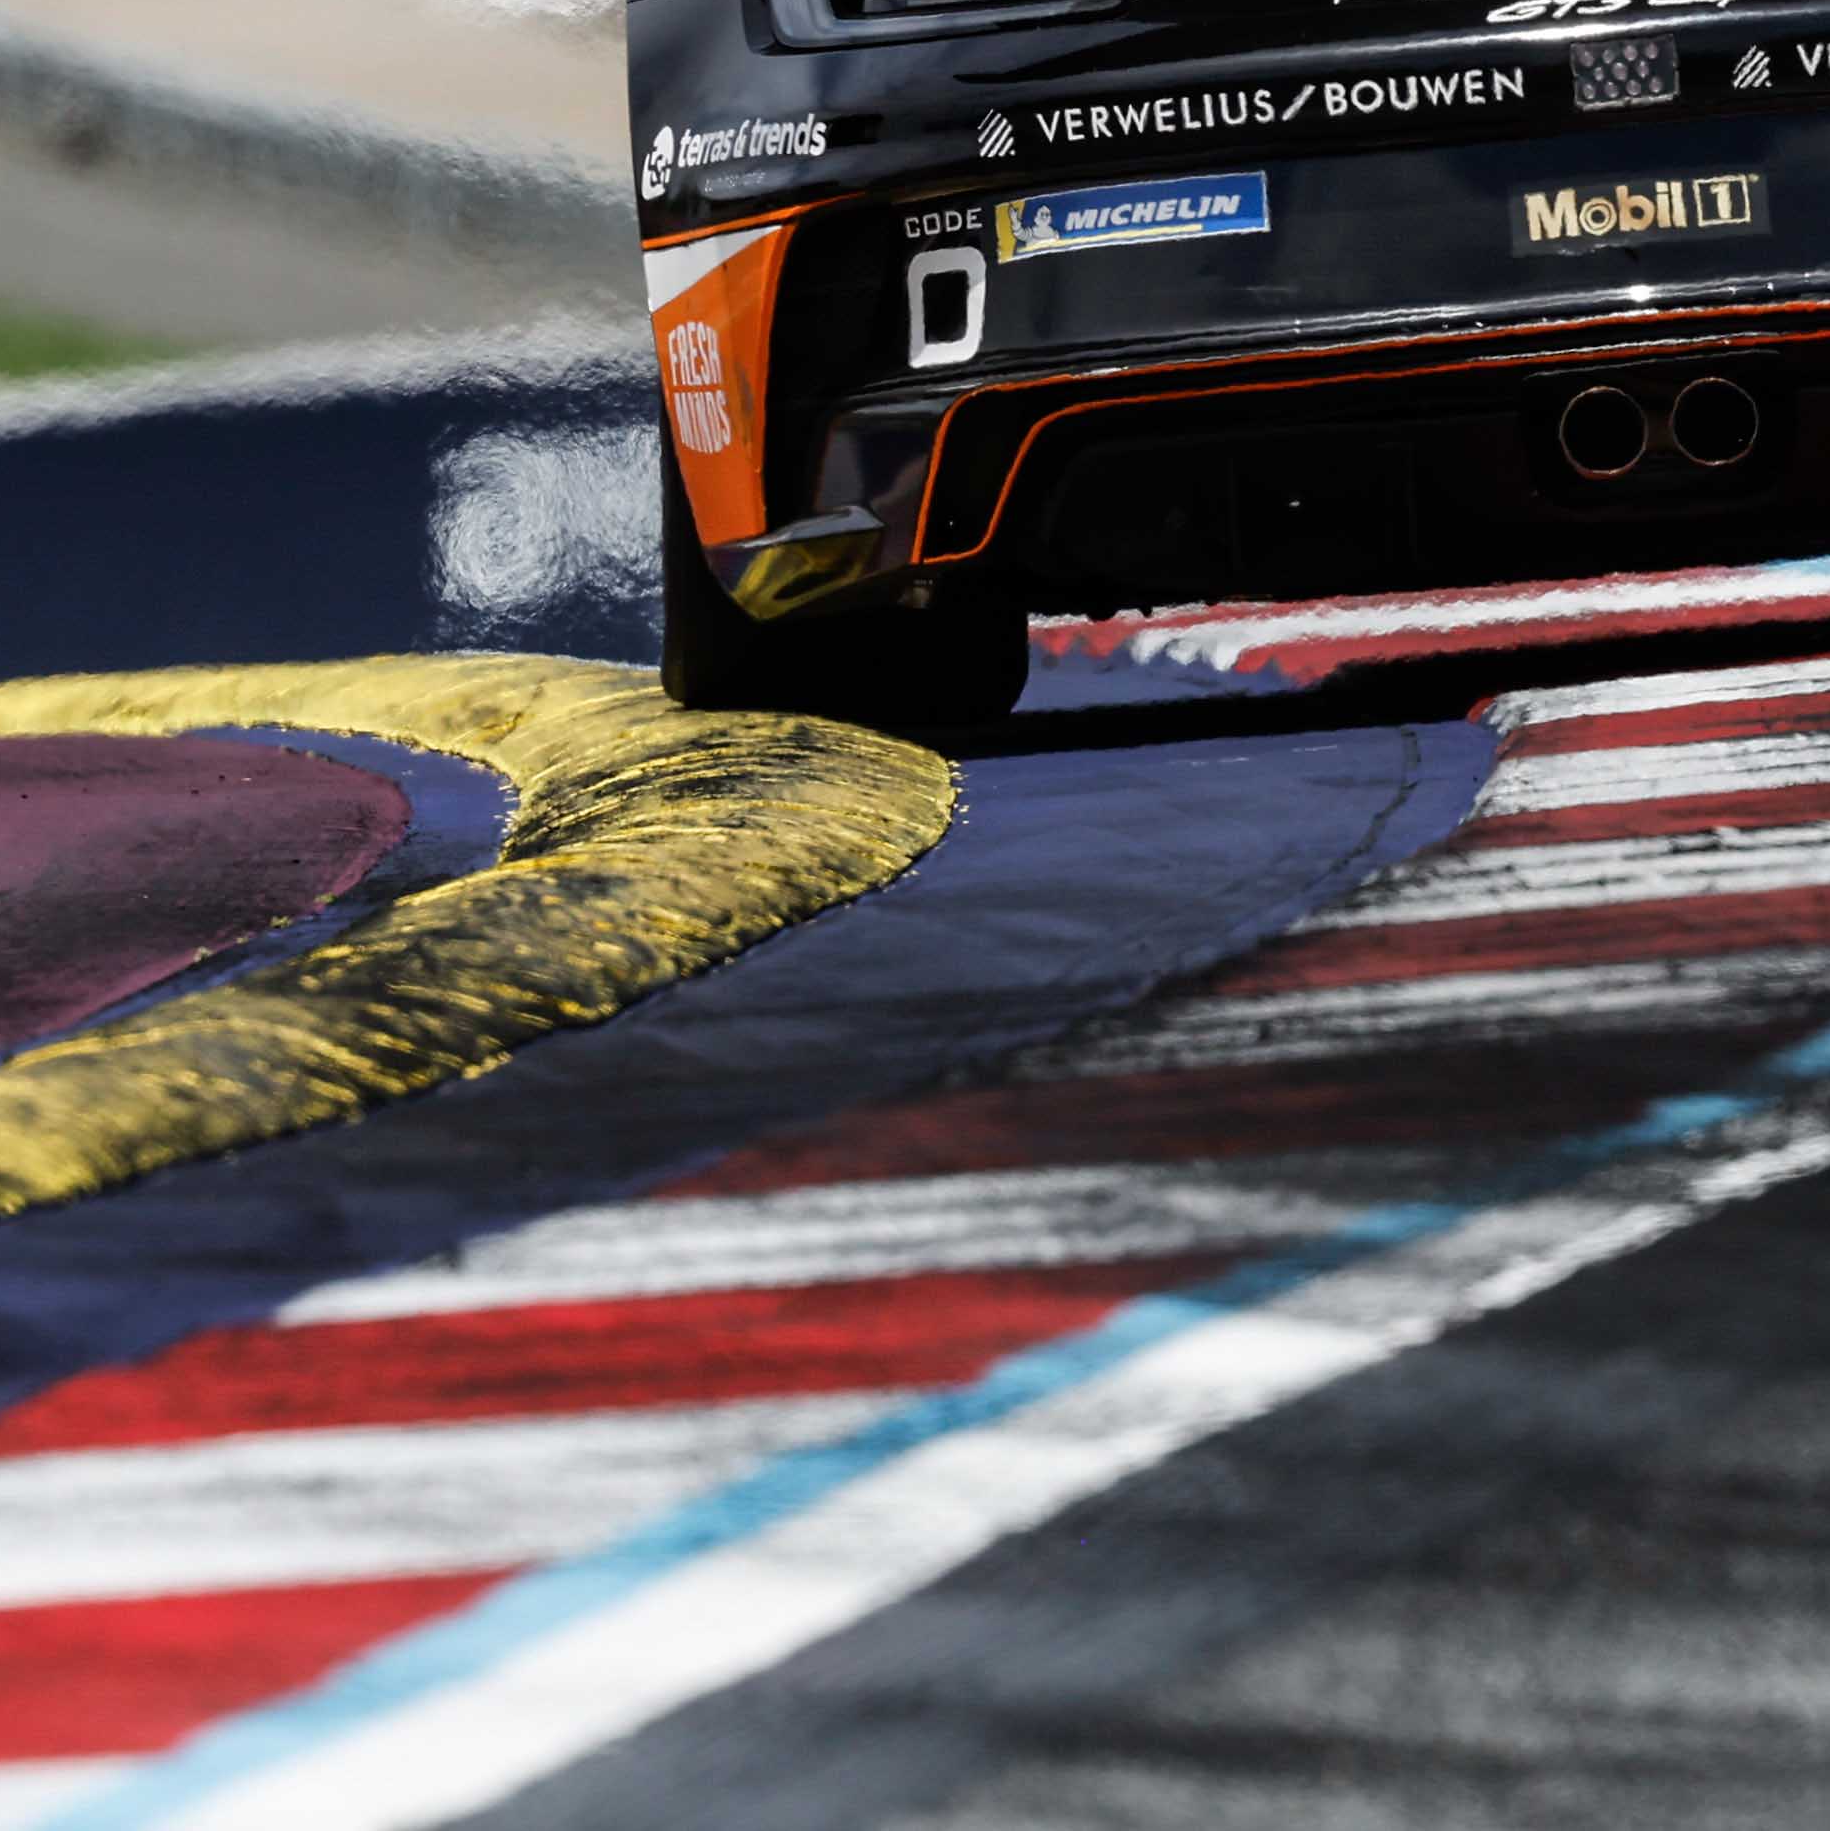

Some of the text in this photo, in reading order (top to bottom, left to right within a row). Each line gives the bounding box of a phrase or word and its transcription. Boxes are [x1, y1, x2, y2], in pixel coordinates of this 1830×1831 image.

[677, 127, 736, 168] terras
[748, 112, 828, 157] trends
[904, 207, 984, 239] CODE
[1064, 194, 1242, 232] MICHELIN
[1524, 180, 1689, 242] Mobil
[668, 321, 723, 387] FRESH
[672, 389, 732, 455] MINDS
